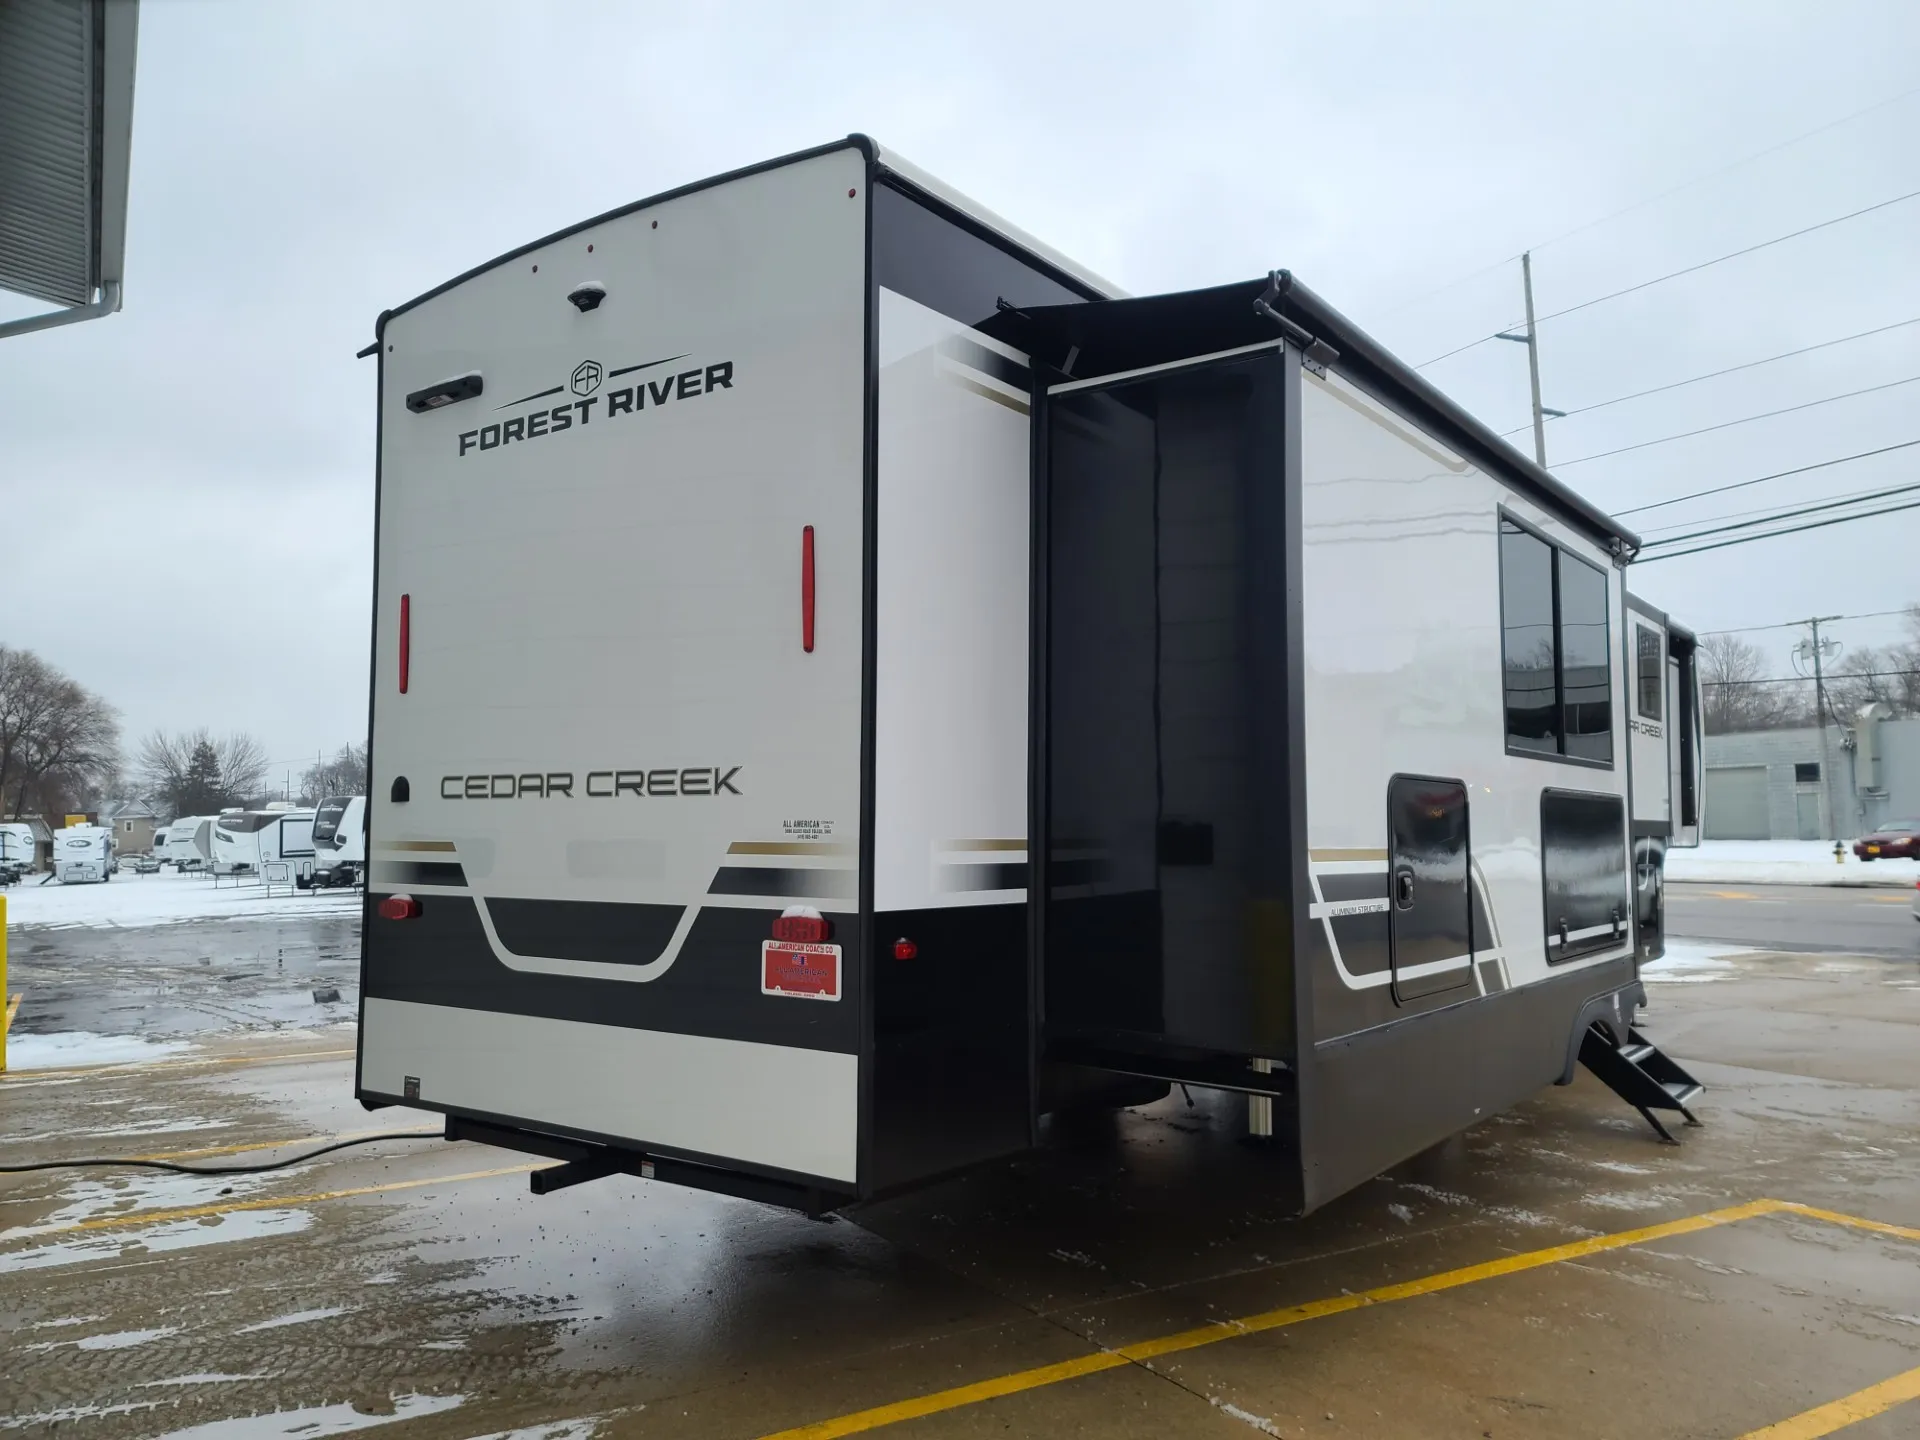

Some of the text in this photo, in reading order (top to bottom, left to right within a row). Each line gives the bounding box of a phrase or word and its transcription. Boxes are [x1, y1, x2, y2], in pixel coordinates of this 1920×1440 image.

[458, 361, 733, 457] FOREST RIVER
[1641, 723, 1663, 739] CREEK
[440, 765, 743, 799] CEDAR CREEK
[783, 820, 792, 828] ALL
[793, 820, 819, 828] AMERICAN
[1331, 904, 1384, 916] ALUMINUM STRUCTURE
[778, 943, 804, 951] AMERICAN
[805, 944, 824, 953] COACH
